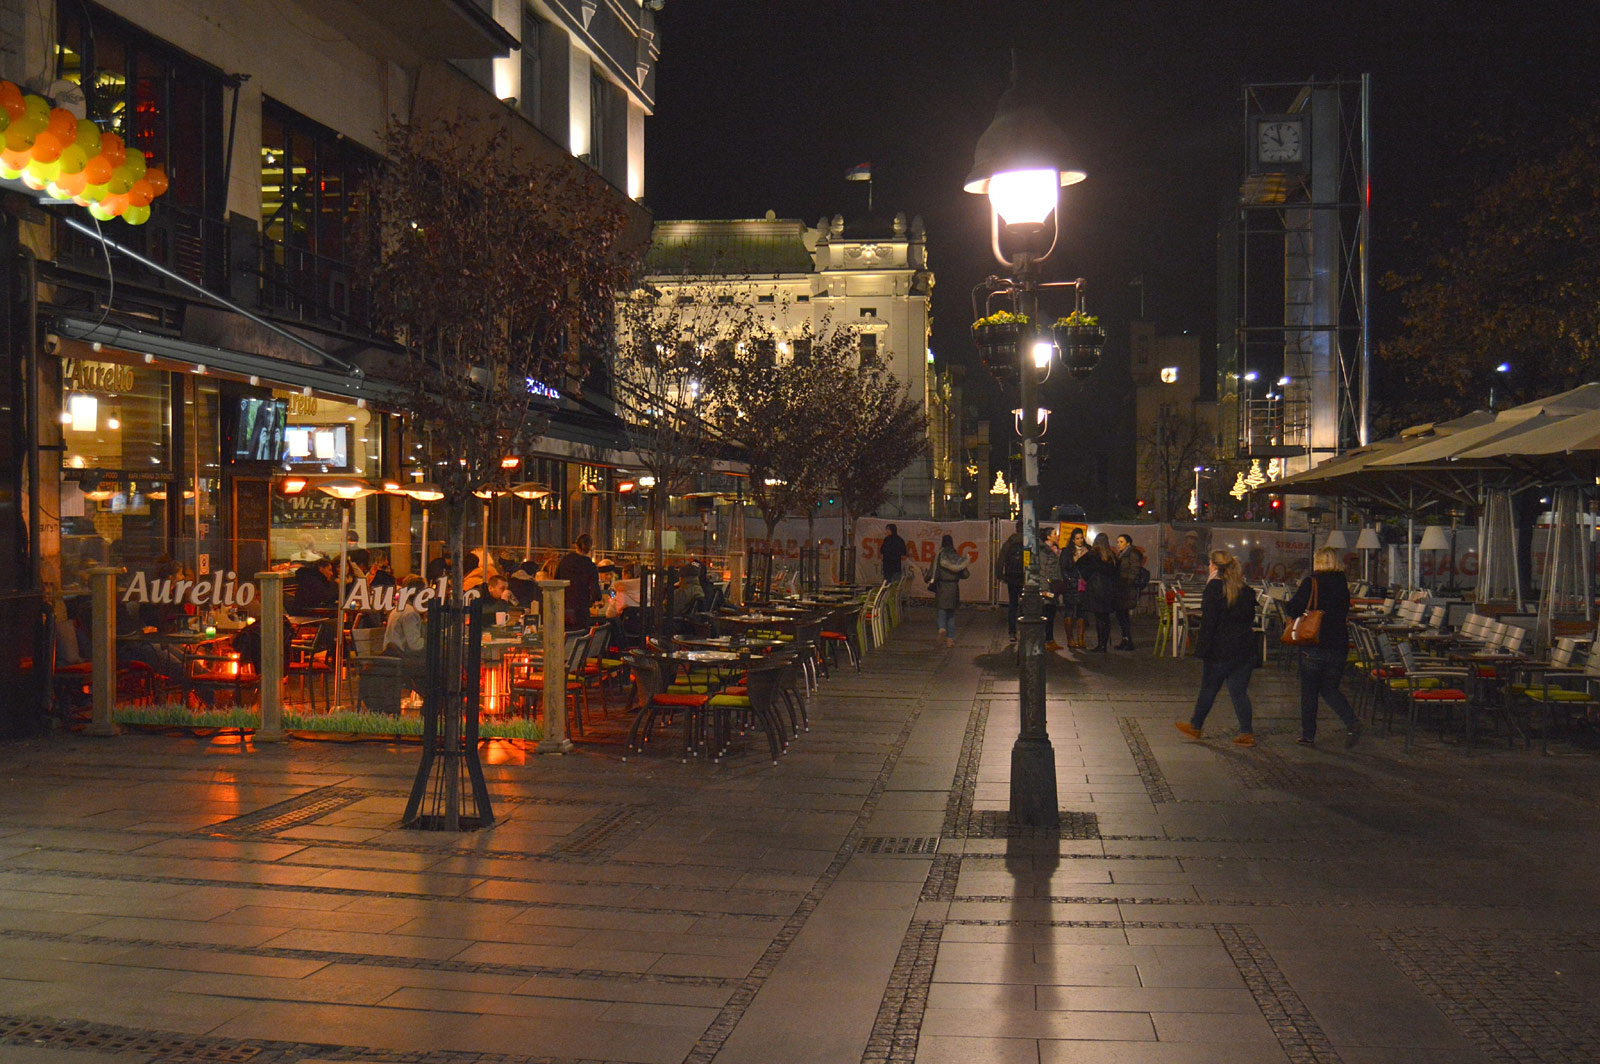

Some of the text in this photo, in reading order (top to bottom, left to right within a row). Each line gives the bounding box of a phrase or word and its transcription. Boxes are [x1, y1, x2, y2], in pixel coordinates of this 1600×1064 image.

[72, 360, 134, 392] Aurelio
[288, 496, 337, 510] Wi-Fi
[862, 537, 979, 564] STABG
[121, 569, 255, 606] Aurelio
[342, 576, 481, 613] Aurelo
